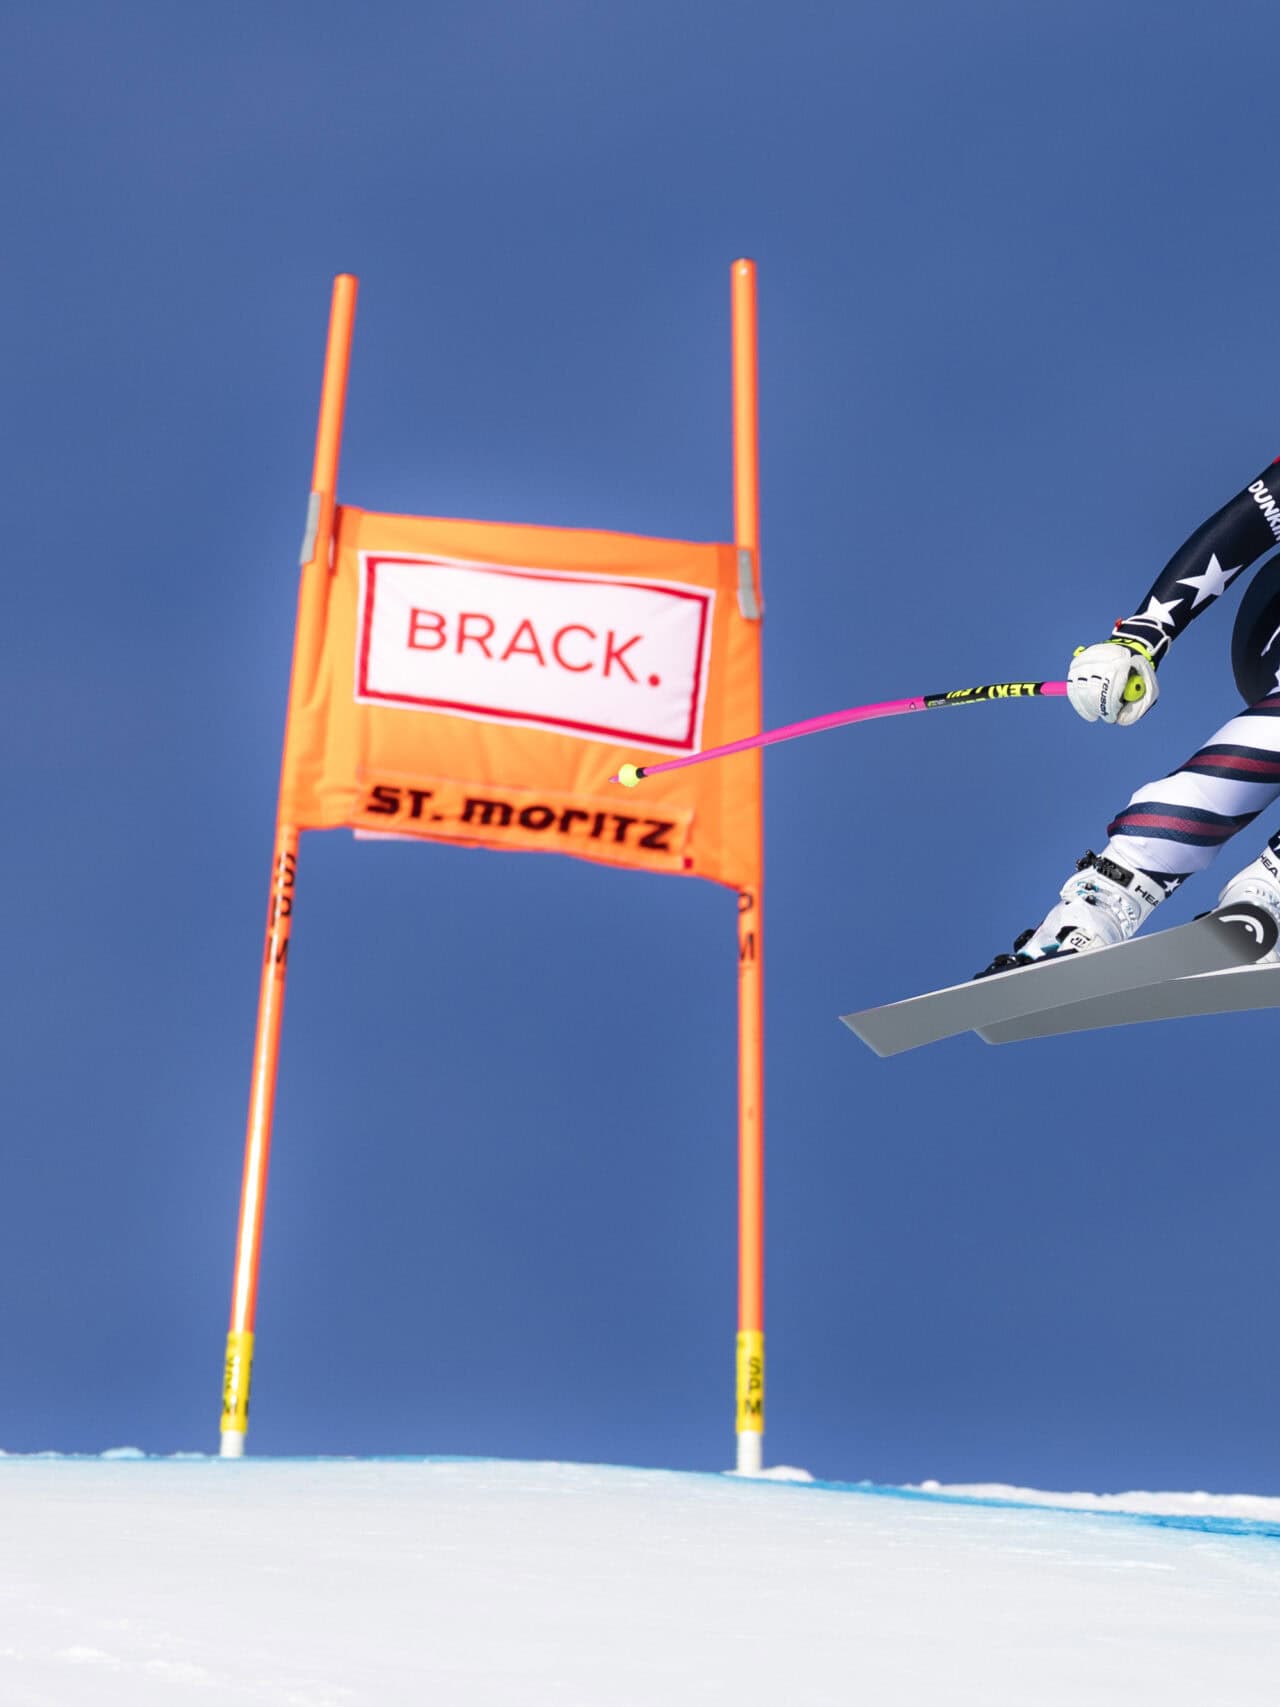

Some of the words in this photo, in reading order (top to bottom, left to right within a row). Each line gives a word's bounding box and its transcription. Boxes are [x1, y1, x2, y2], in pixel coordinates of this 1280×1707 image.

[406, 607, 661, 687] BRACK.
[366, 785, 443, 822] ST.
[1133, 885, 1160, 906] HEA
